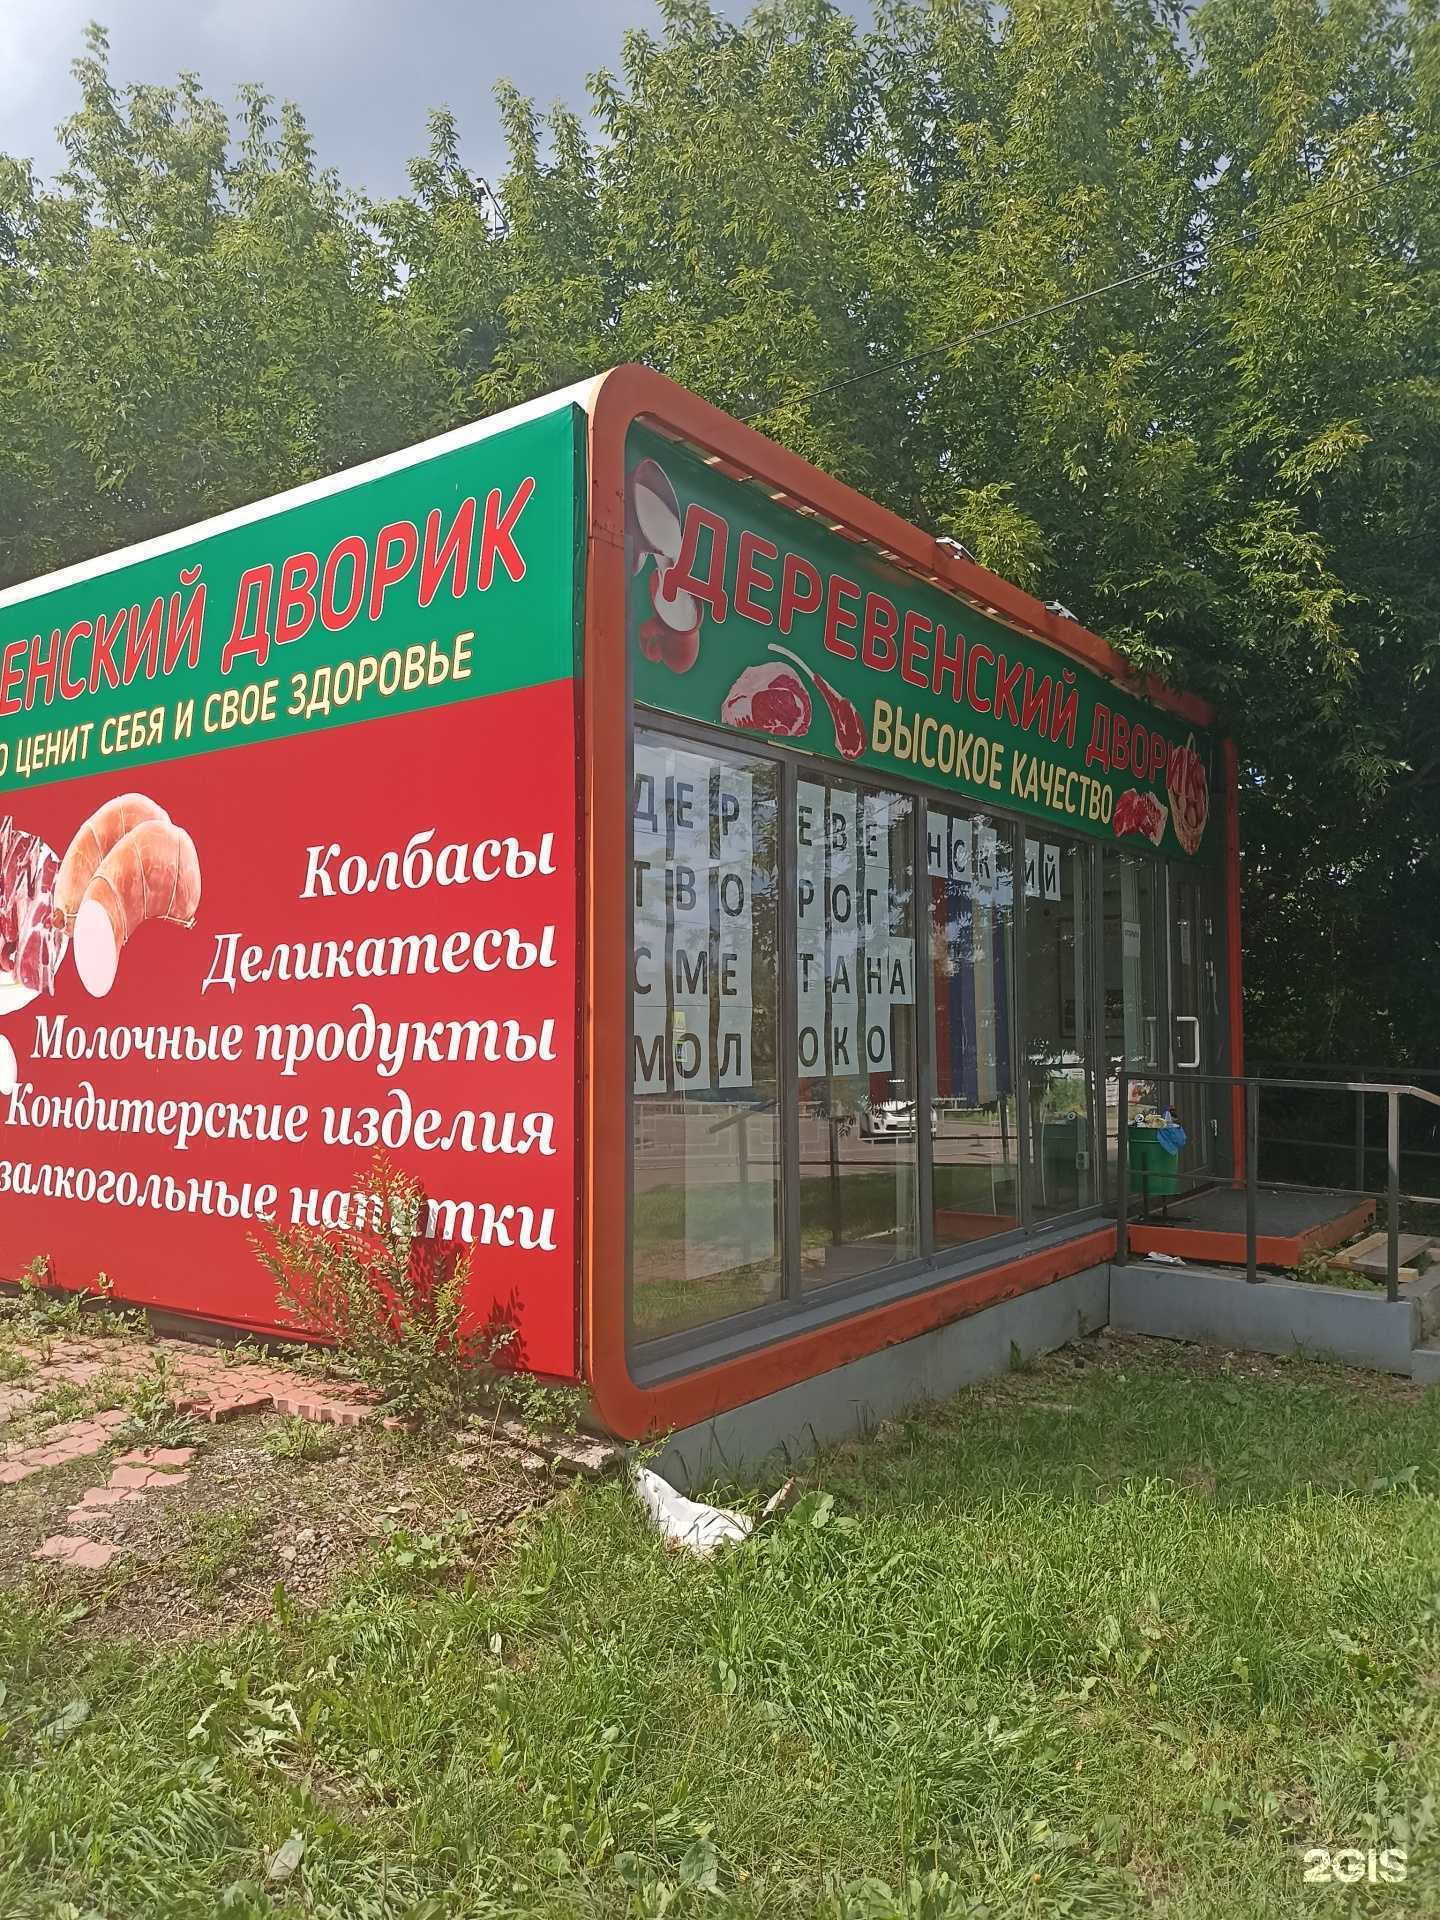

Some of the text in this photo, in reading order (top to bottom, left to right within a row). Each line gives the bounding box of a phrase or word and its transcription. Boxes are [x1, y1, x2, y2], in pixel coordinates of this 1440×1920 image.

[0, 476, 536, 716] ЕНСКИЙ ДВОРИК
[662, 503, 1081, 748] ДЕРЕВЕНСКИЙ
[15, 722, 95, 778] ЦЕНИТ
[100, 706, 166, 756] СЕБЯ
[173, 699, 195, 742] И
[203, 679, 280, 734] СВОЕ
[287, 631, 476, 719] ЗДОРОВЬЕ
[871, 699, 1113, 825] ВЫСОКОЕ КАЧЕСТВО
[300, 827, 557, 899] Колбасы
[201, 924, 558, 994] Деликатесы
[30, 1003, 558, 1077] Молочные продукты
[4, 1081, 558, 1156] Кондитерские изделия
[0, 1160, 278, 1222] залкогольные
